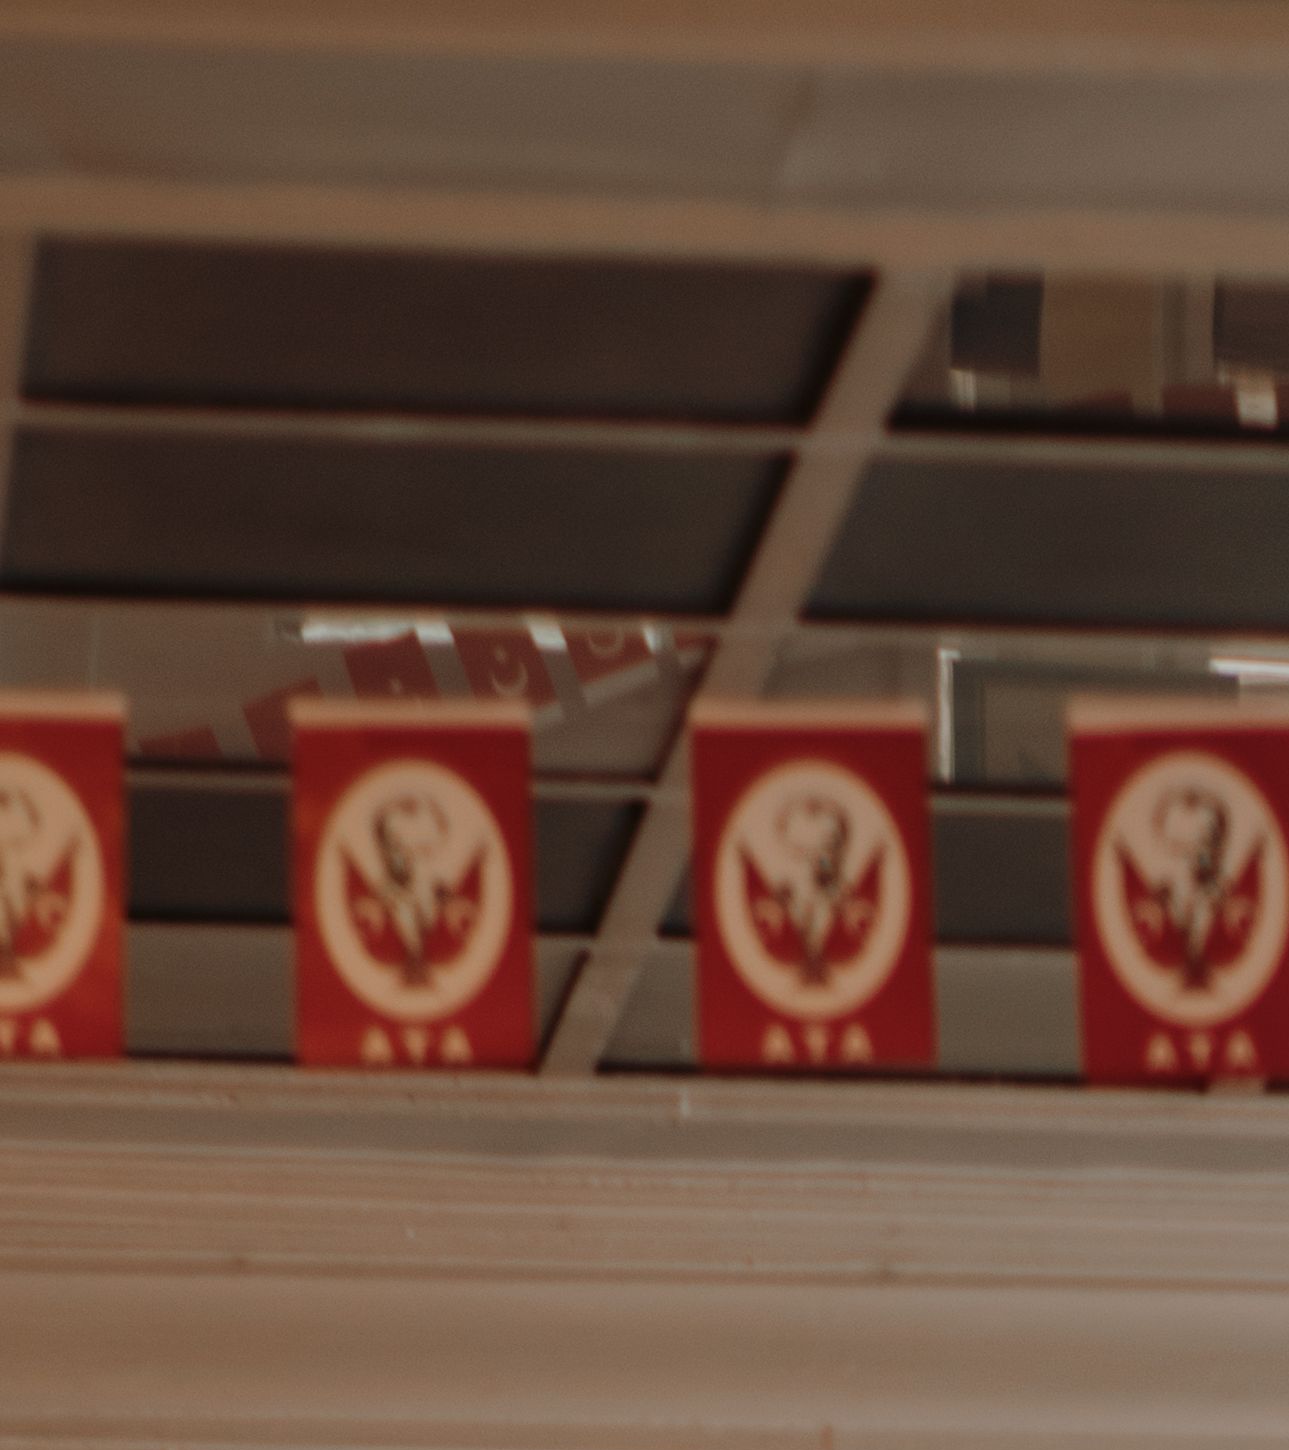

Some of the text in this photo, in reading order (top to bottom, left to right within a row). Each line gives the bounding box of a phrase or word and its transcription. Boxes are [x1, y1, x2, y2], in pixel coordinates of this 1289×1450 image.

[0, 1017, 61, 1056] TA
[360, 1024, 474, 1064] ATA
[761, 1023, 874, 1065] ATA
[1145, 1030, 1257, 1071] ATA
